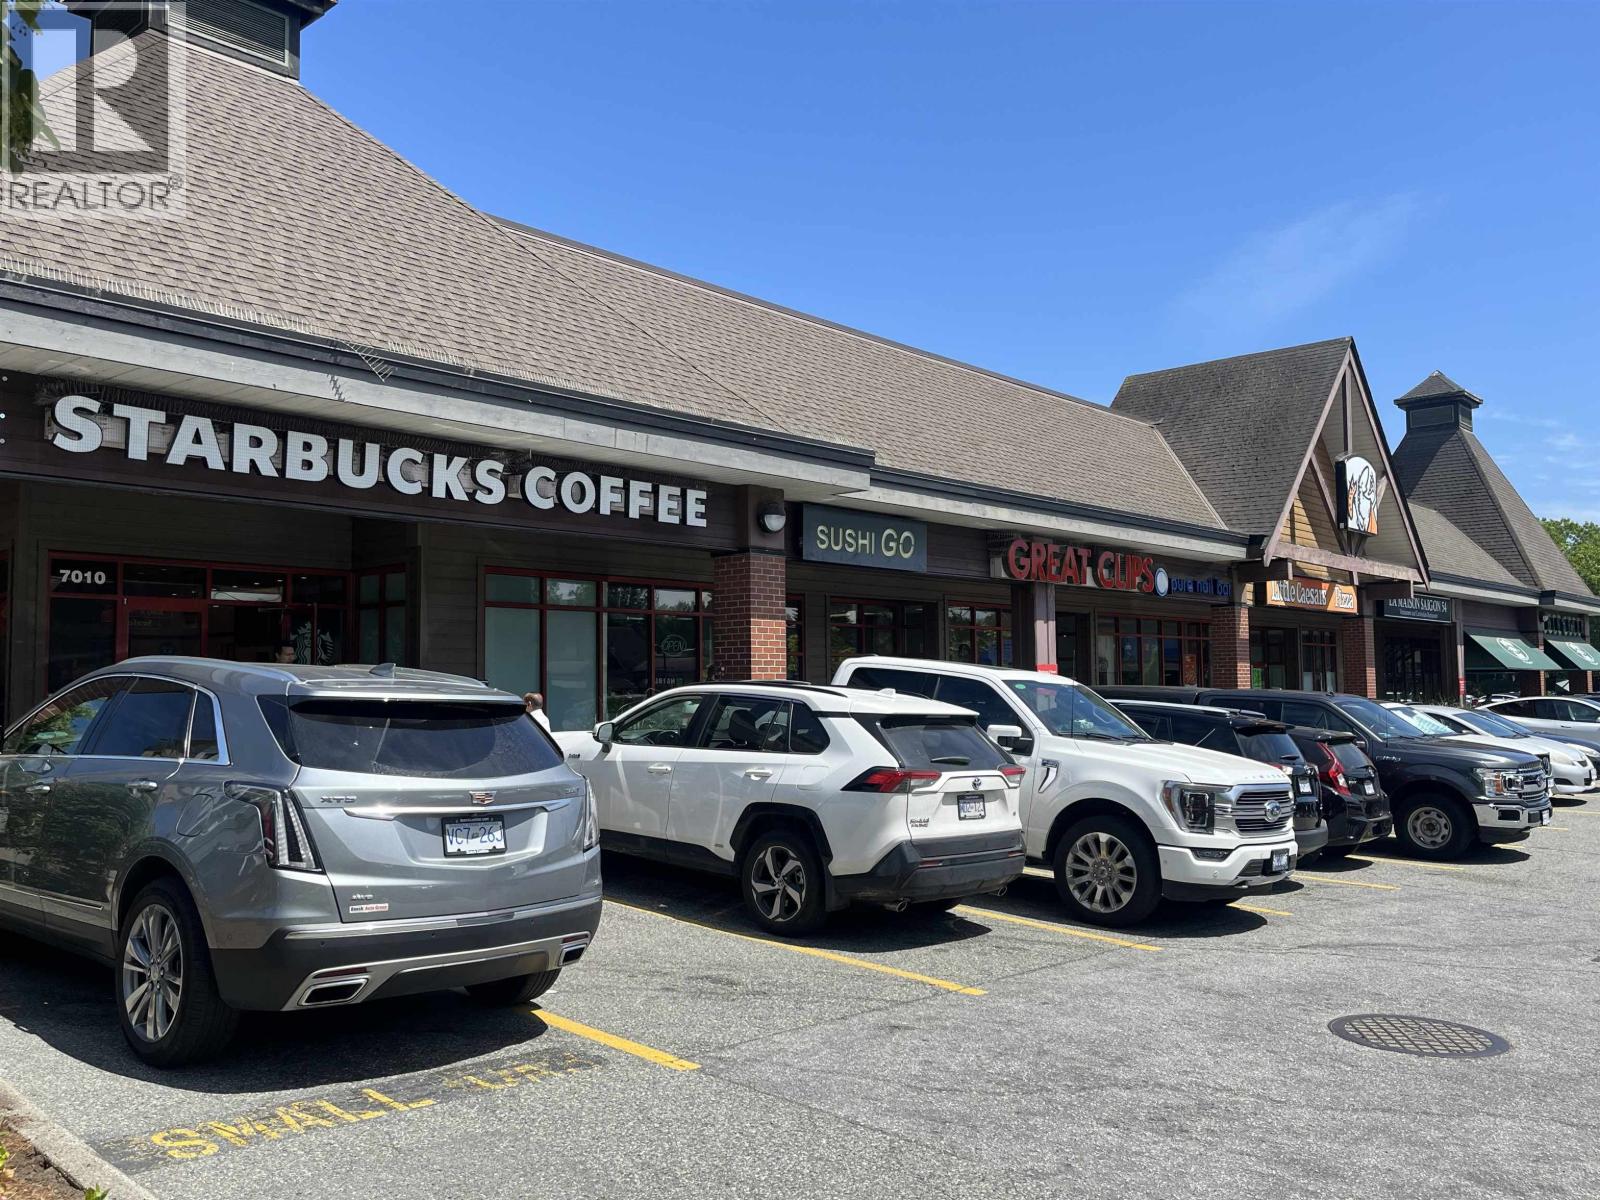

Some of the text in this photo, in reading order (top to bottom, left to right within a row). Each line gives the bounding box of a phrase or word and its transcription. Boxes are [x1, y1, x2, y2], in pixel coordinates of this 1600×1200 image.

[53, 395, 708, 528] STARBUCKS COFFEE
[816, 525, 915, 559] SUSHI GO
[59, 569, 106, 585] 7010
[1008, 539, 1154, 593] GREAT CLIPS
[1296, 582, 1327, 605] Caesars
